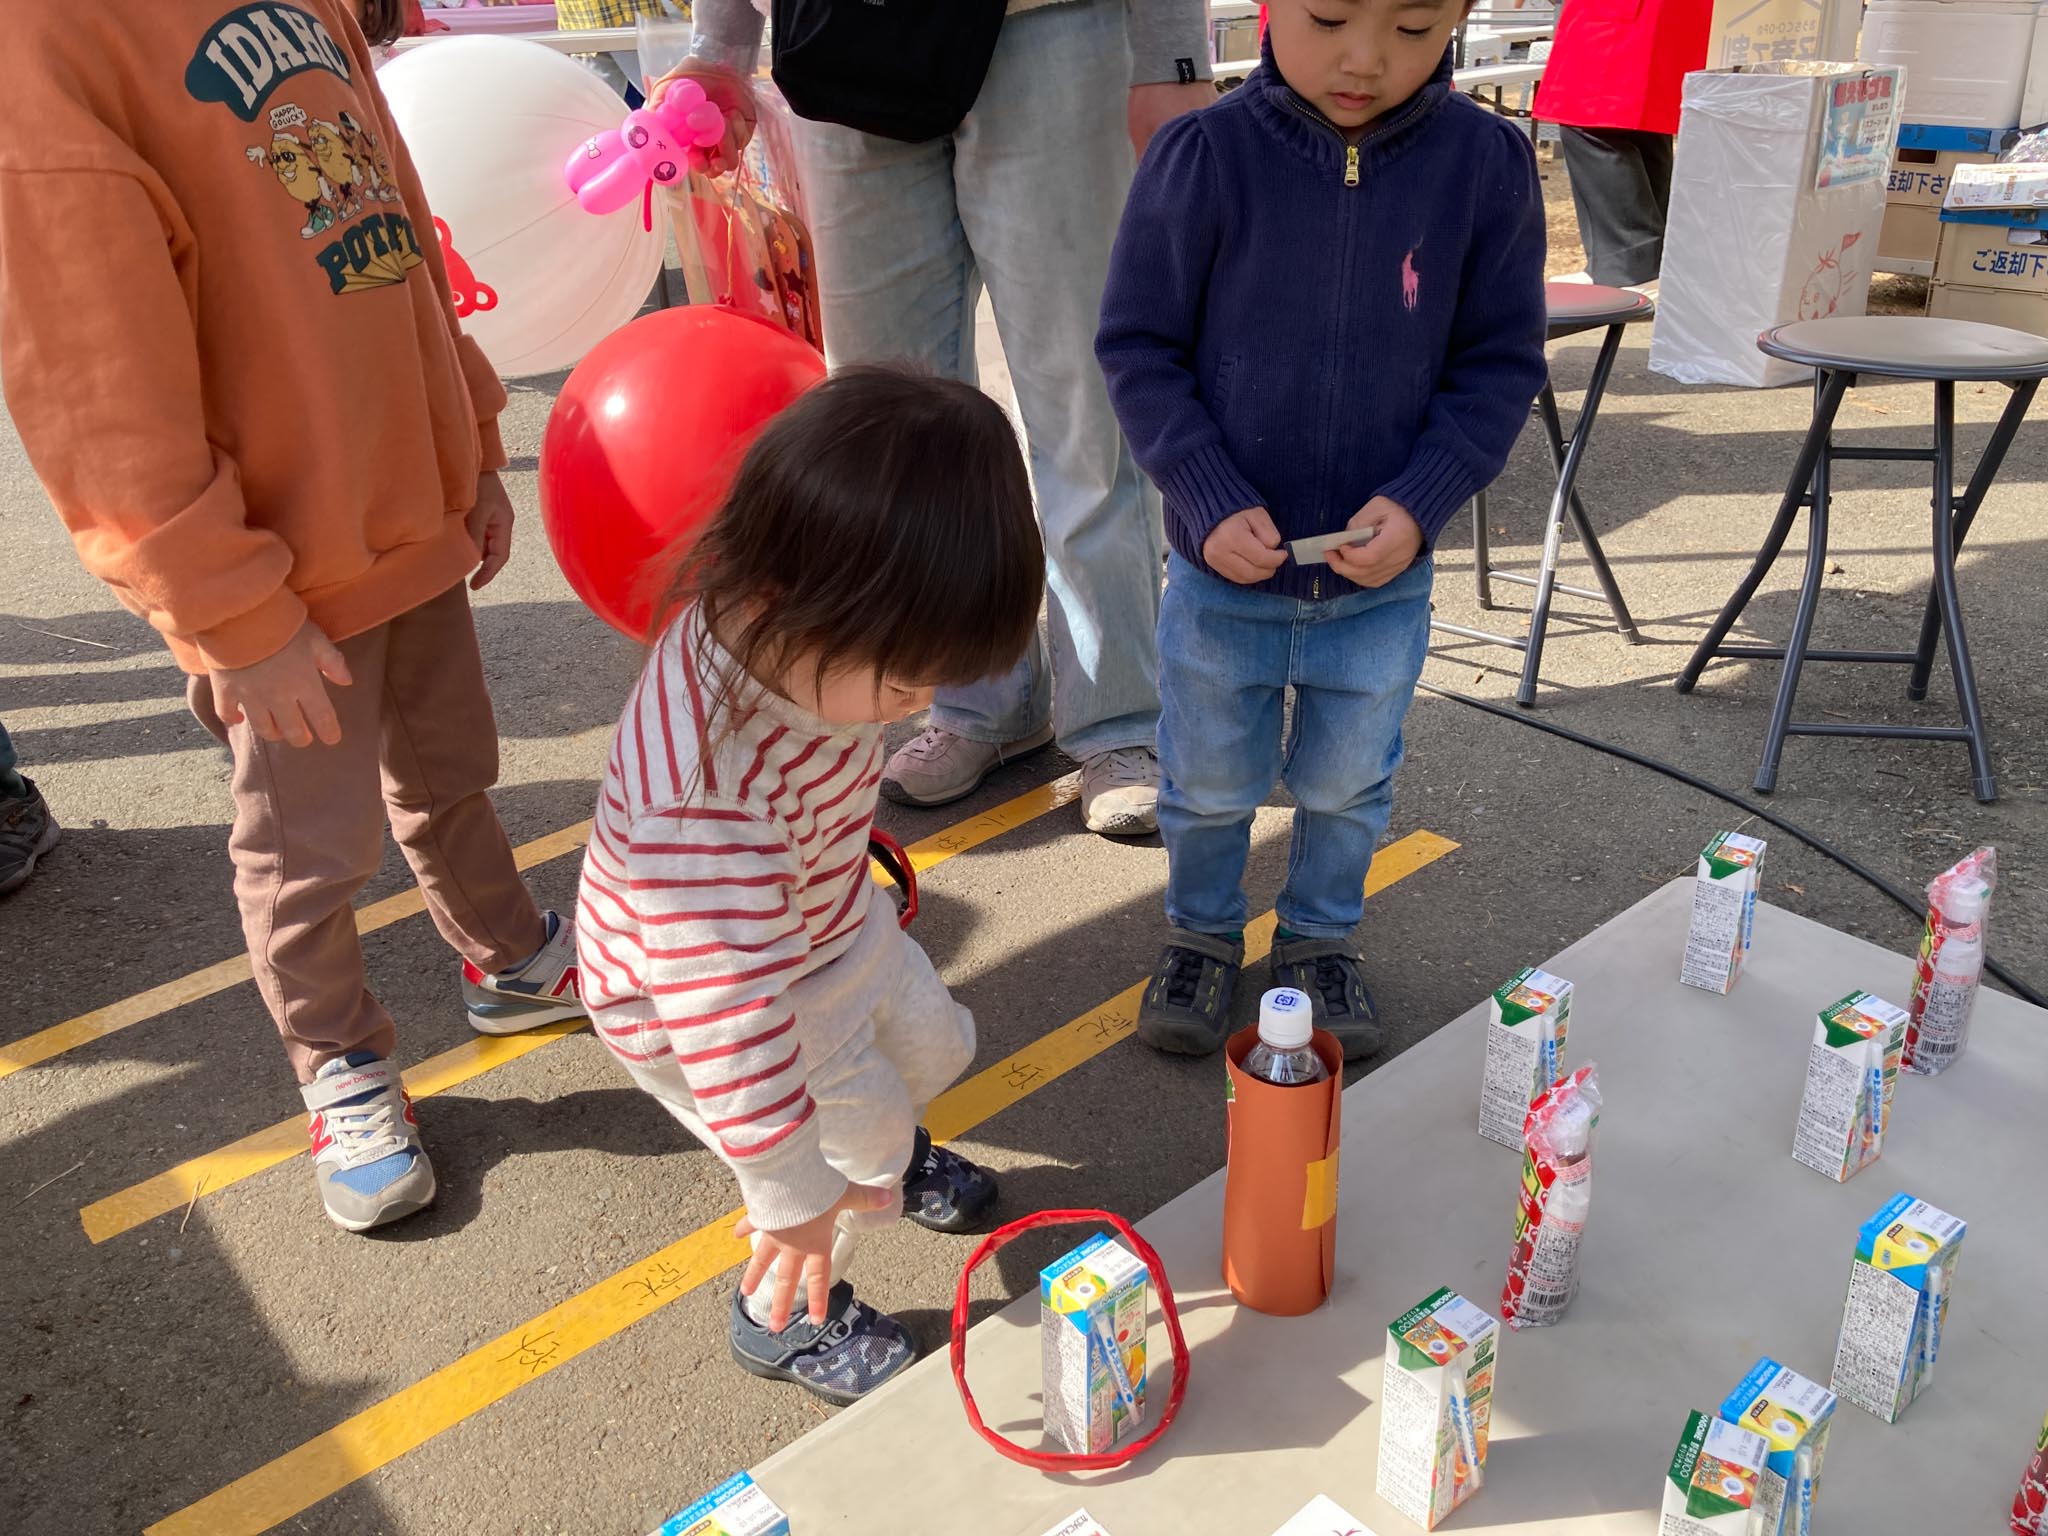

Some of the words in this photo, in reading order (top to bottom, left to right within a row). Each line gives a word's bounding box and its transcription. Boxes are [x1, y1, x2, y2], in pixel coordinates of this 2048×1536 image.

[205, 8, 350, 110] IDAHO
[273, 105, 296, 118] HAPPY
[1973, 249, 2048, 278] ご返却下
[1694, 1415, 1709, 1441] KAGOME
[1681, 1441, 1699, 1478] 野菜生活100
